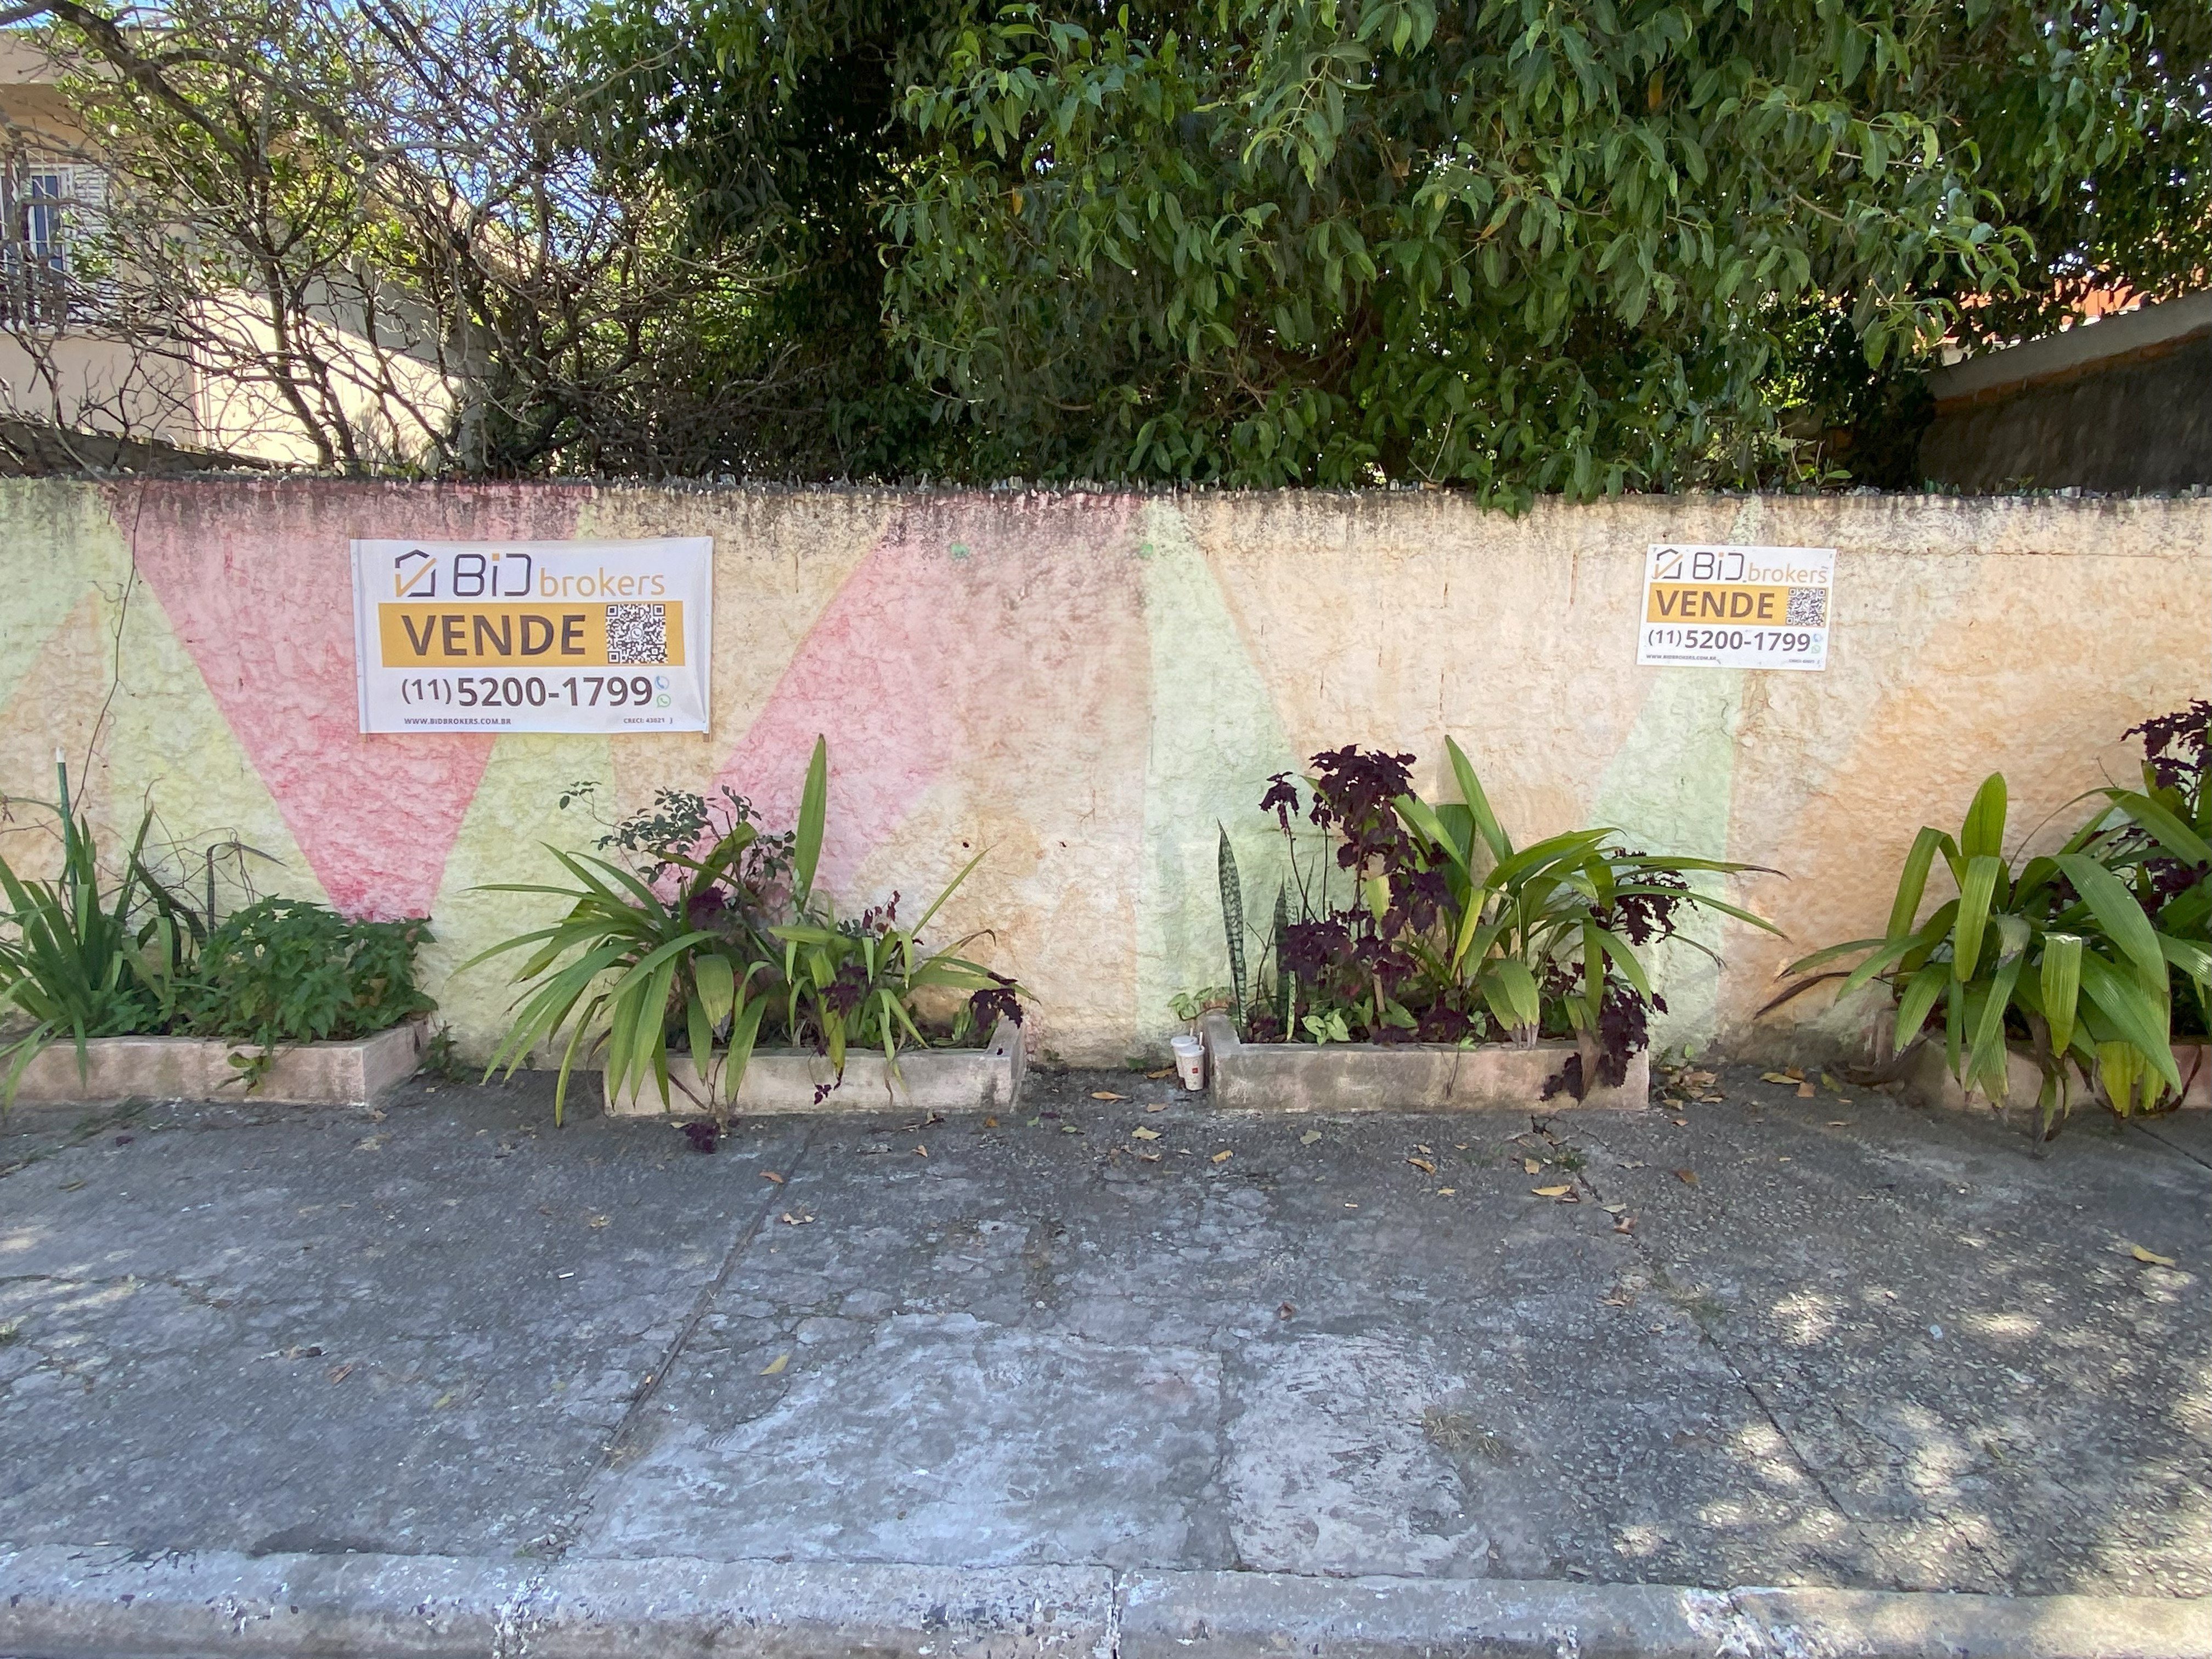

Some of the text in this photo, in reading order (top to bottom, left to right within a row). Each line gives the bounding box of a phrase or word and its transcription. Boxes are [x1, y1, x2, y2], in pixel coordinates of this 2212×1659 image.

[540, 567, 665, 597] brokers
[1748, 562, 1827, 584] brokers
[1656, 590, 1775, 619] VENDE
[401, 614, 586, 656] VENDE
